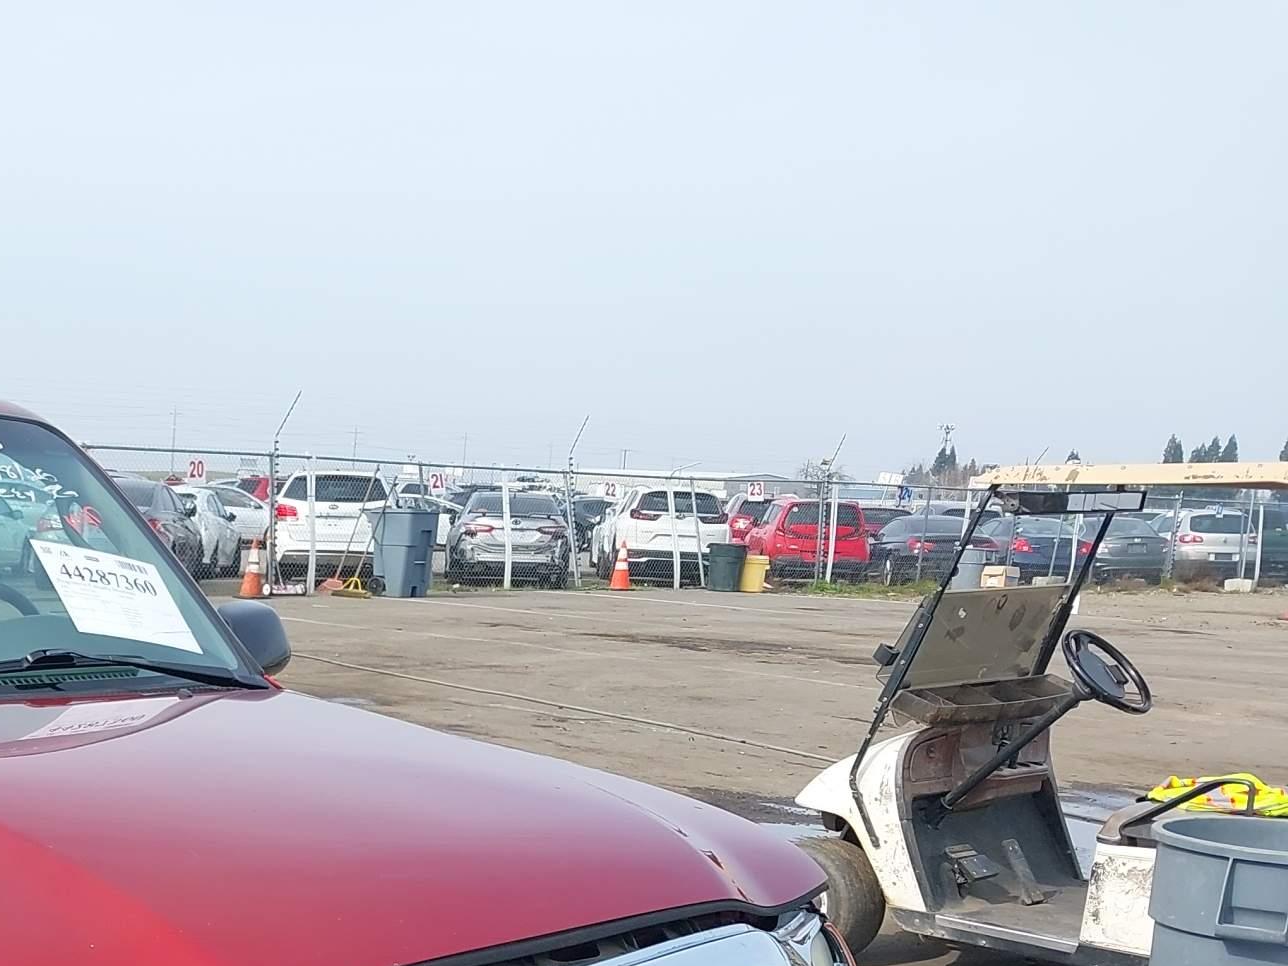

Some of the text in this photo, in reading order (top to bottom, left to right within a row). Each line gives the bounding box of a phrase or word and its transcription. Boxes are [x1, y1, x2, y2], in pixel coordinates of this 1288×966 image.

[189, 460, 204, 478] 20
[431, 473, 444, 489] 21
[605, 481, 616, 497] 22
[749, 482, 763, 496] 23
[60, 563, 157, 597] 44287360
